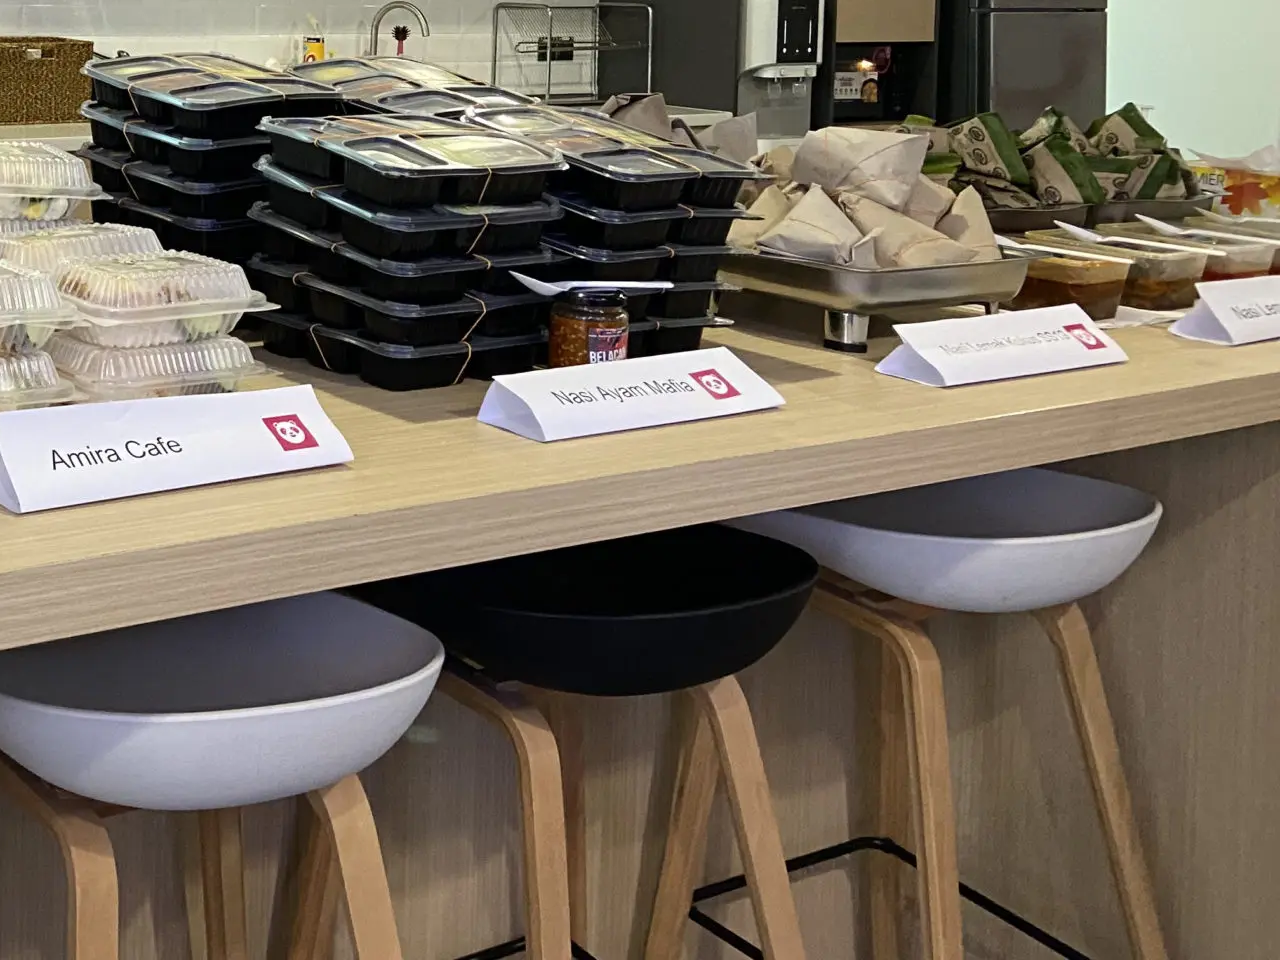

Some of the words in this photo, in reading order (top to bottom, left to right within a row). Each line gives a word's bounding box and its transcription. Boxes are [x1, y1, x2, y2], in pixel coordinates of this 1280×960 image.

[550, 389, 599, 405] Nasi
[596, 385, 648, 403] Ayam
[642, 378, 696, 395] Mafia
[52, 445, 122, 471] Amira
[124, 436, 183, 459] Cafe
